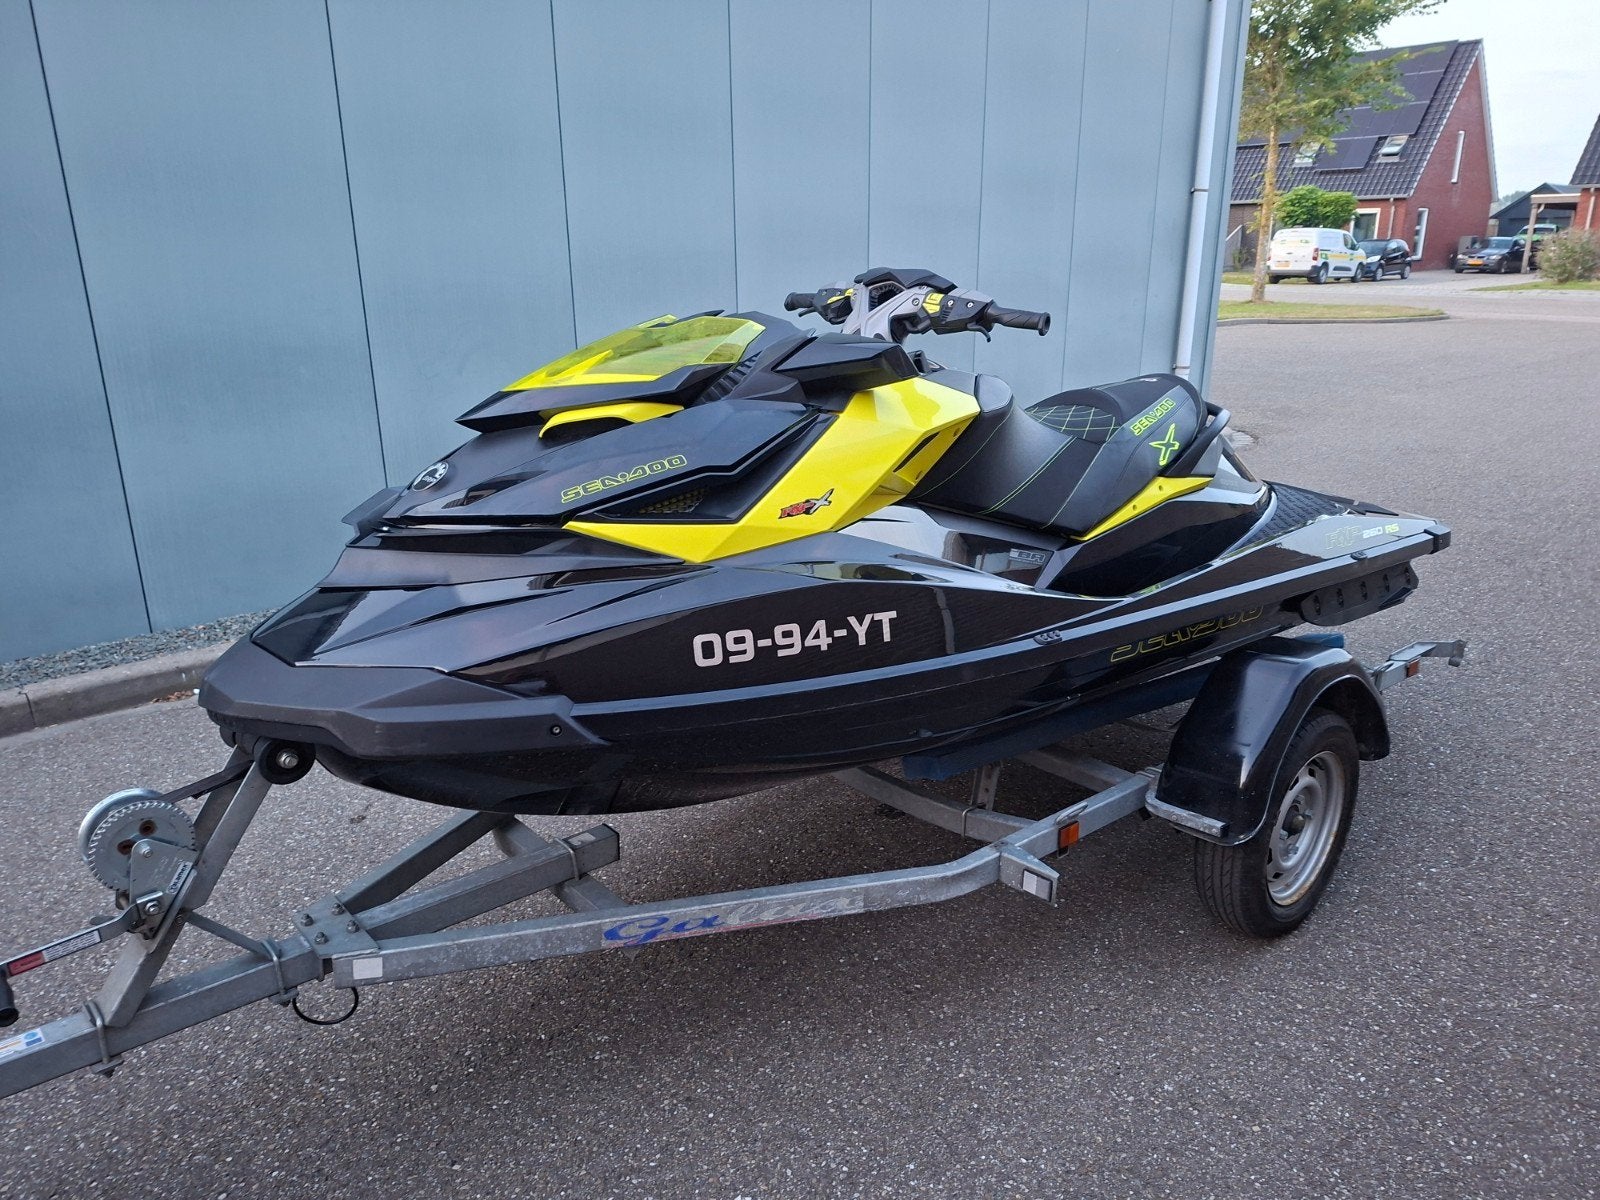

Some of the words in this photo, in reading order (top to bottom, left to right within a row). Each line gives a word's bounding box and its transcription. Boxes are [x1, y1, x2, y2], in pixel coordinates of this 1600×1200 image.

[1362, 526, 1384, 539] 260
[1385, 522, 1400, 534] RS
[692, 610, 898, 668] 09-94-YT
